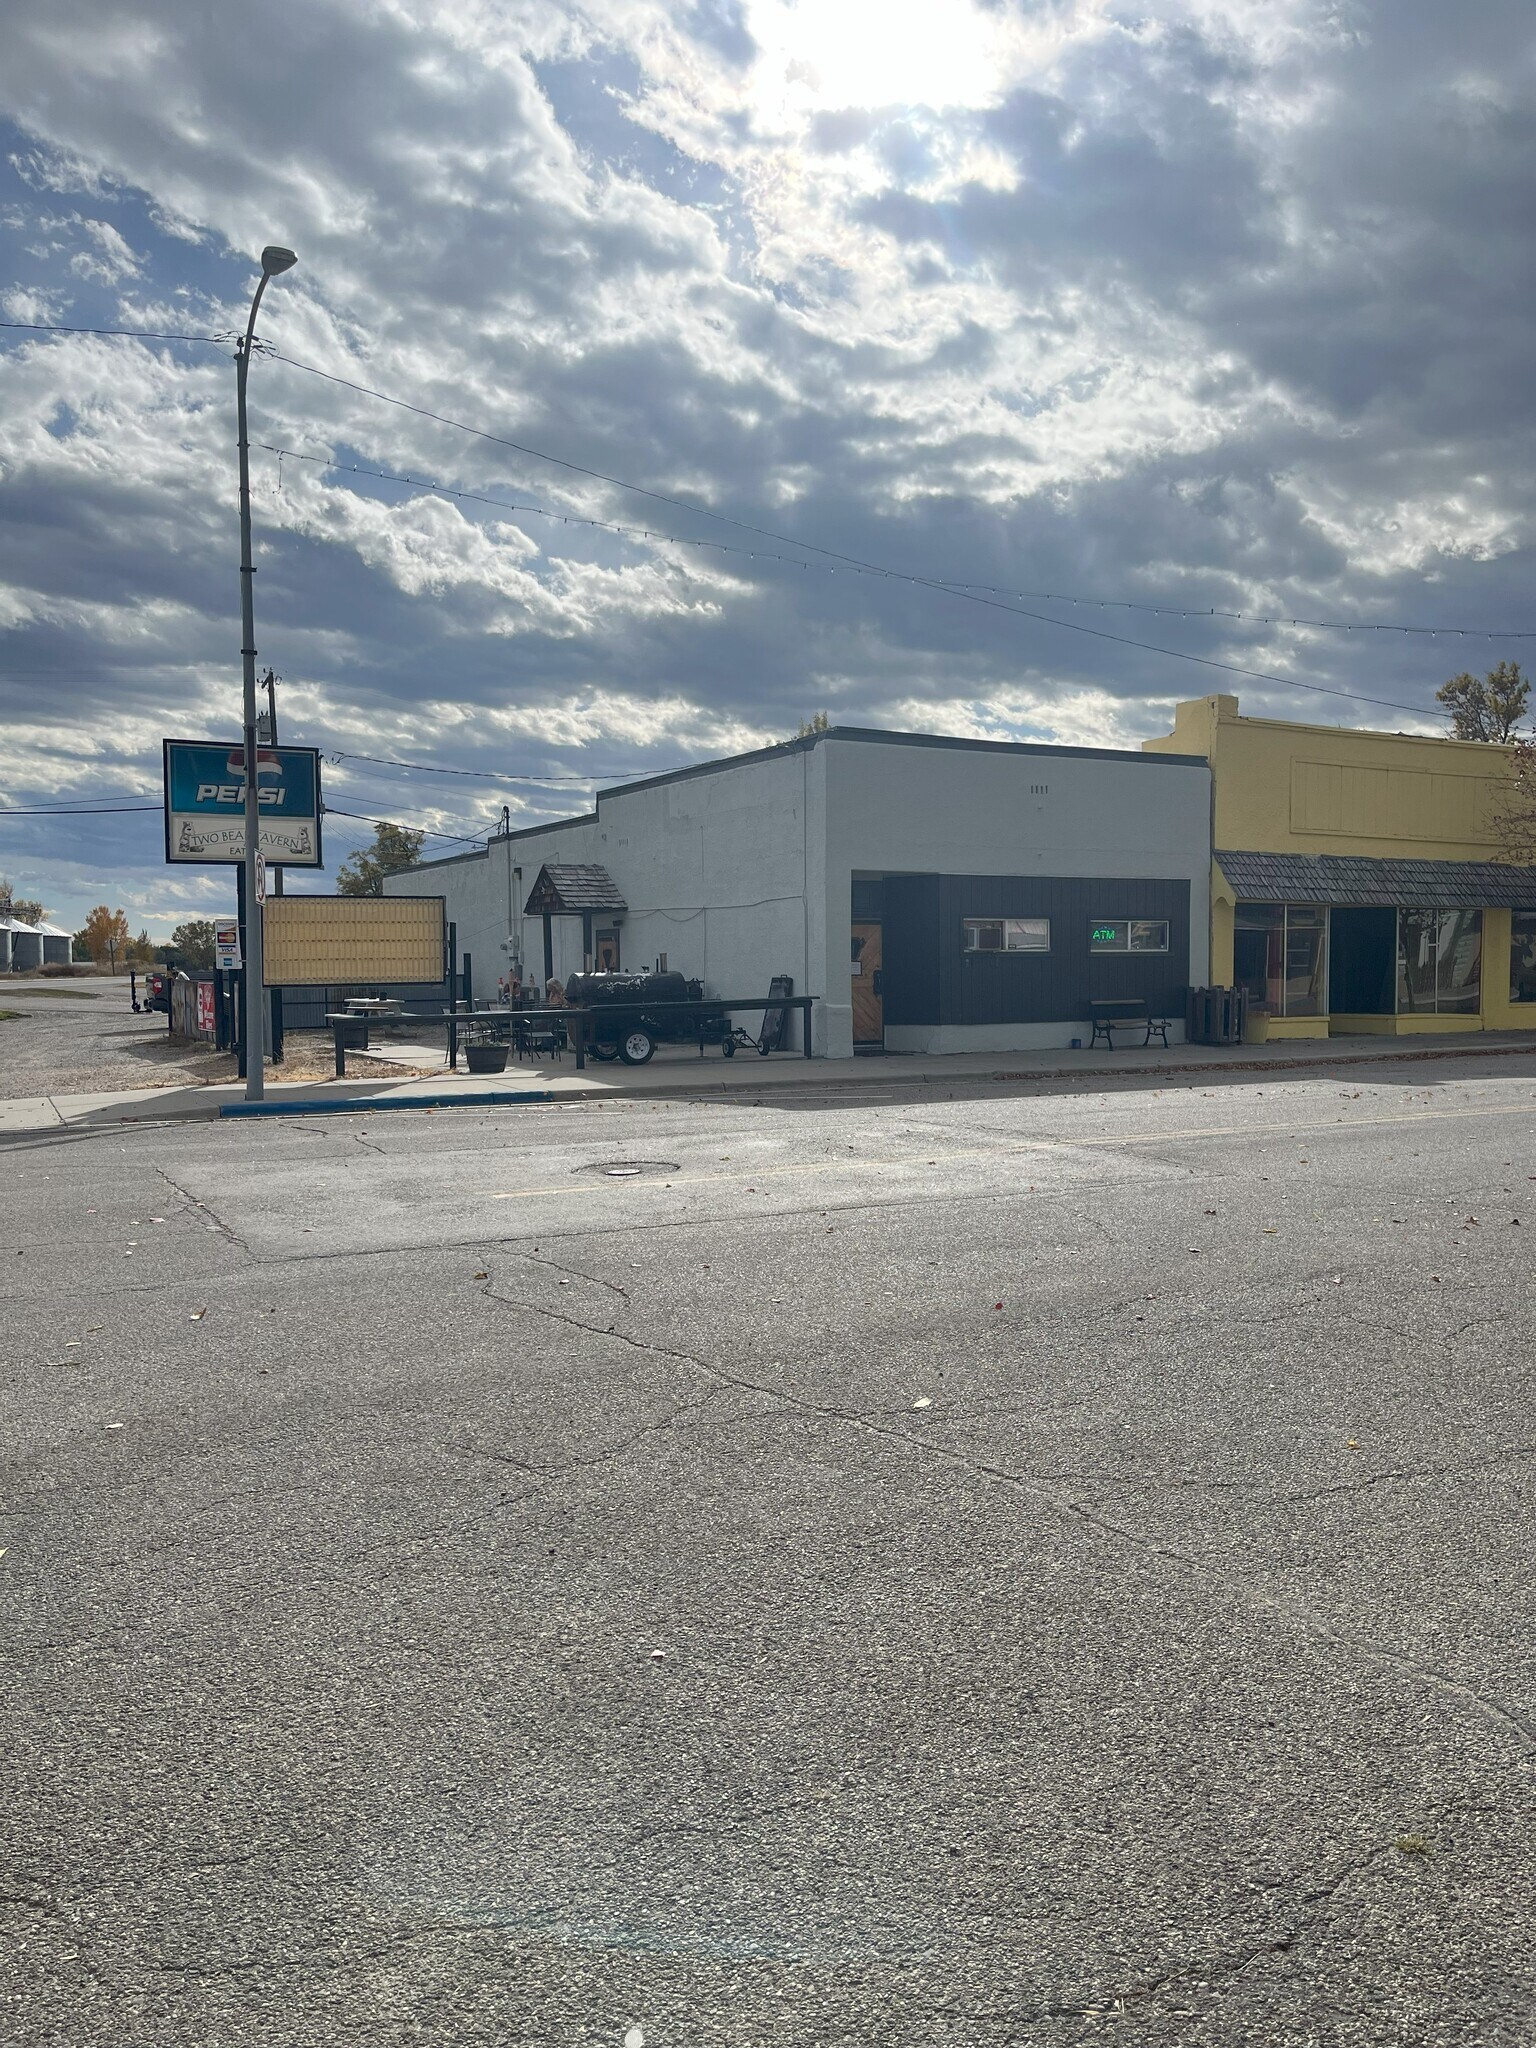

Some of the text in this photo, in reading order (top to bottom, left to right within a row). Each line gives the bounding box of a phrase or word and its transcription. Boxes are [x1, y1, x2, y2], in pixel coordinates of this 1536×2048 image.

[191, 831, 299, 849] TWO BEA AVERN
[1092, 930, 1115, 940] ATM
